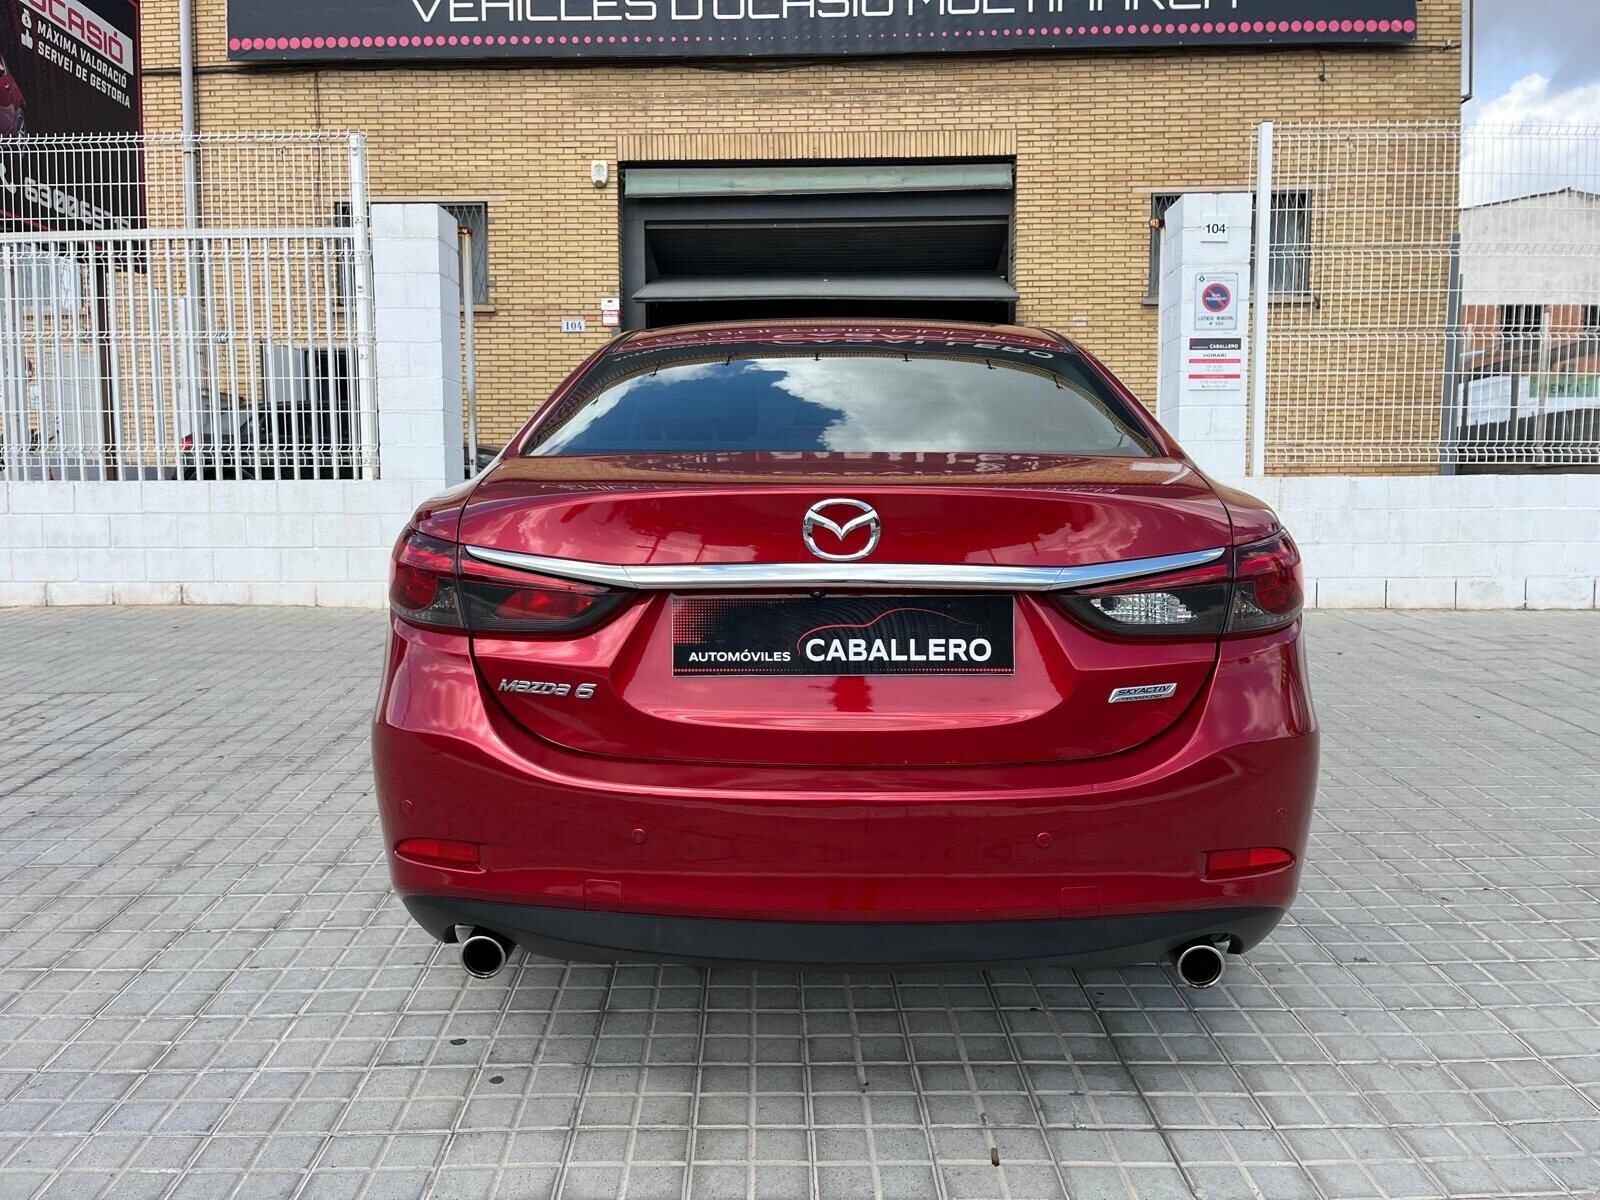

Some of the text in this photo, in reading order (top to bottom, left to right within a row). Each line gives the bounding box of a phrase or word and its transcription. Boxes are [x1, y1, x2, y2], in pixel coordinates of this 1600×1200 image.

[37, 20, 127, 88] MÀXIMA VALORACIÓ
[38, 41, 131, 109] SERVEI DE GESTORIA
[1206, 223, 1226, 234] 104
[566, 321, 582, 331] 104
[689, 638, 992, 662] AUTOMÓVILES CABALLERO
[575, 683, 597, 698] 6
[1117, 685, 1171, 696] SKYACTIV
